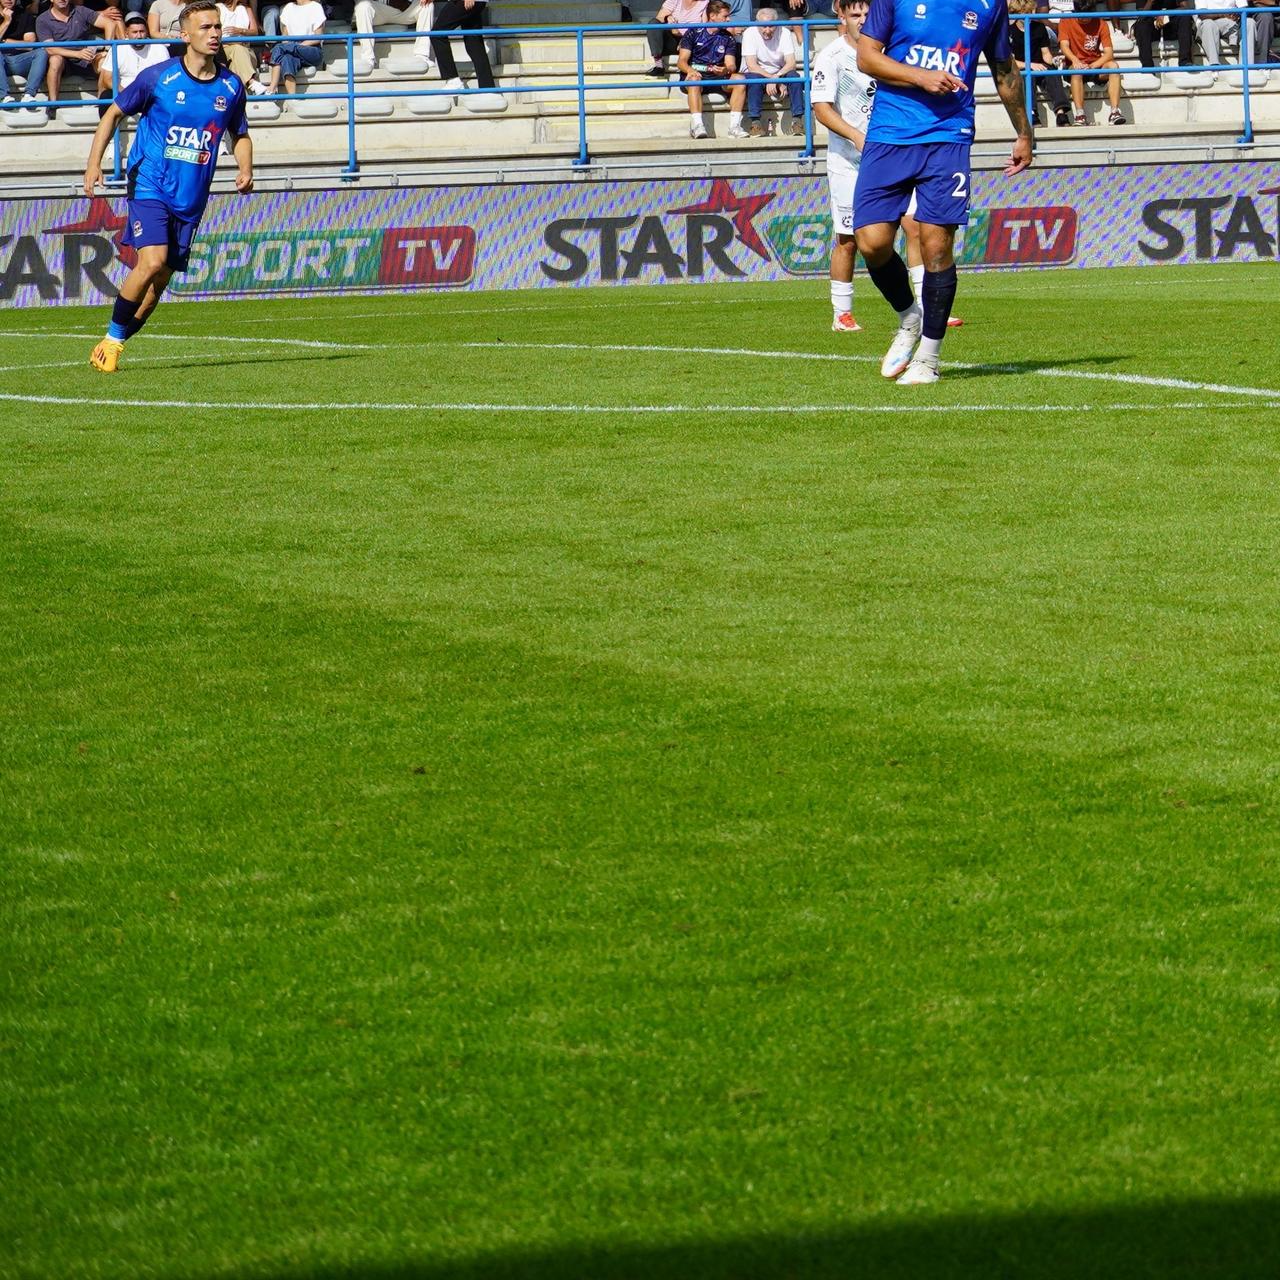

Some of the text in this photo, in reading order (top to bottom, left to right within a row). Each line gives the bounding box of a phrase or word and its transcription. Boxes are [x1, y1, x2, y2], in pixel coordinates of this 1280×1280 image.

[905, 44, 960, 76] STAR
[165, 146, 198, 162] SPORT
[166, 125, 213, 151] STAR
[172, 236, 371, 285] SPORT
[397, 237, 462, 272] TV
[540, 214, 748, 282] STAR
[1003, 219, 1065, 251] TV
